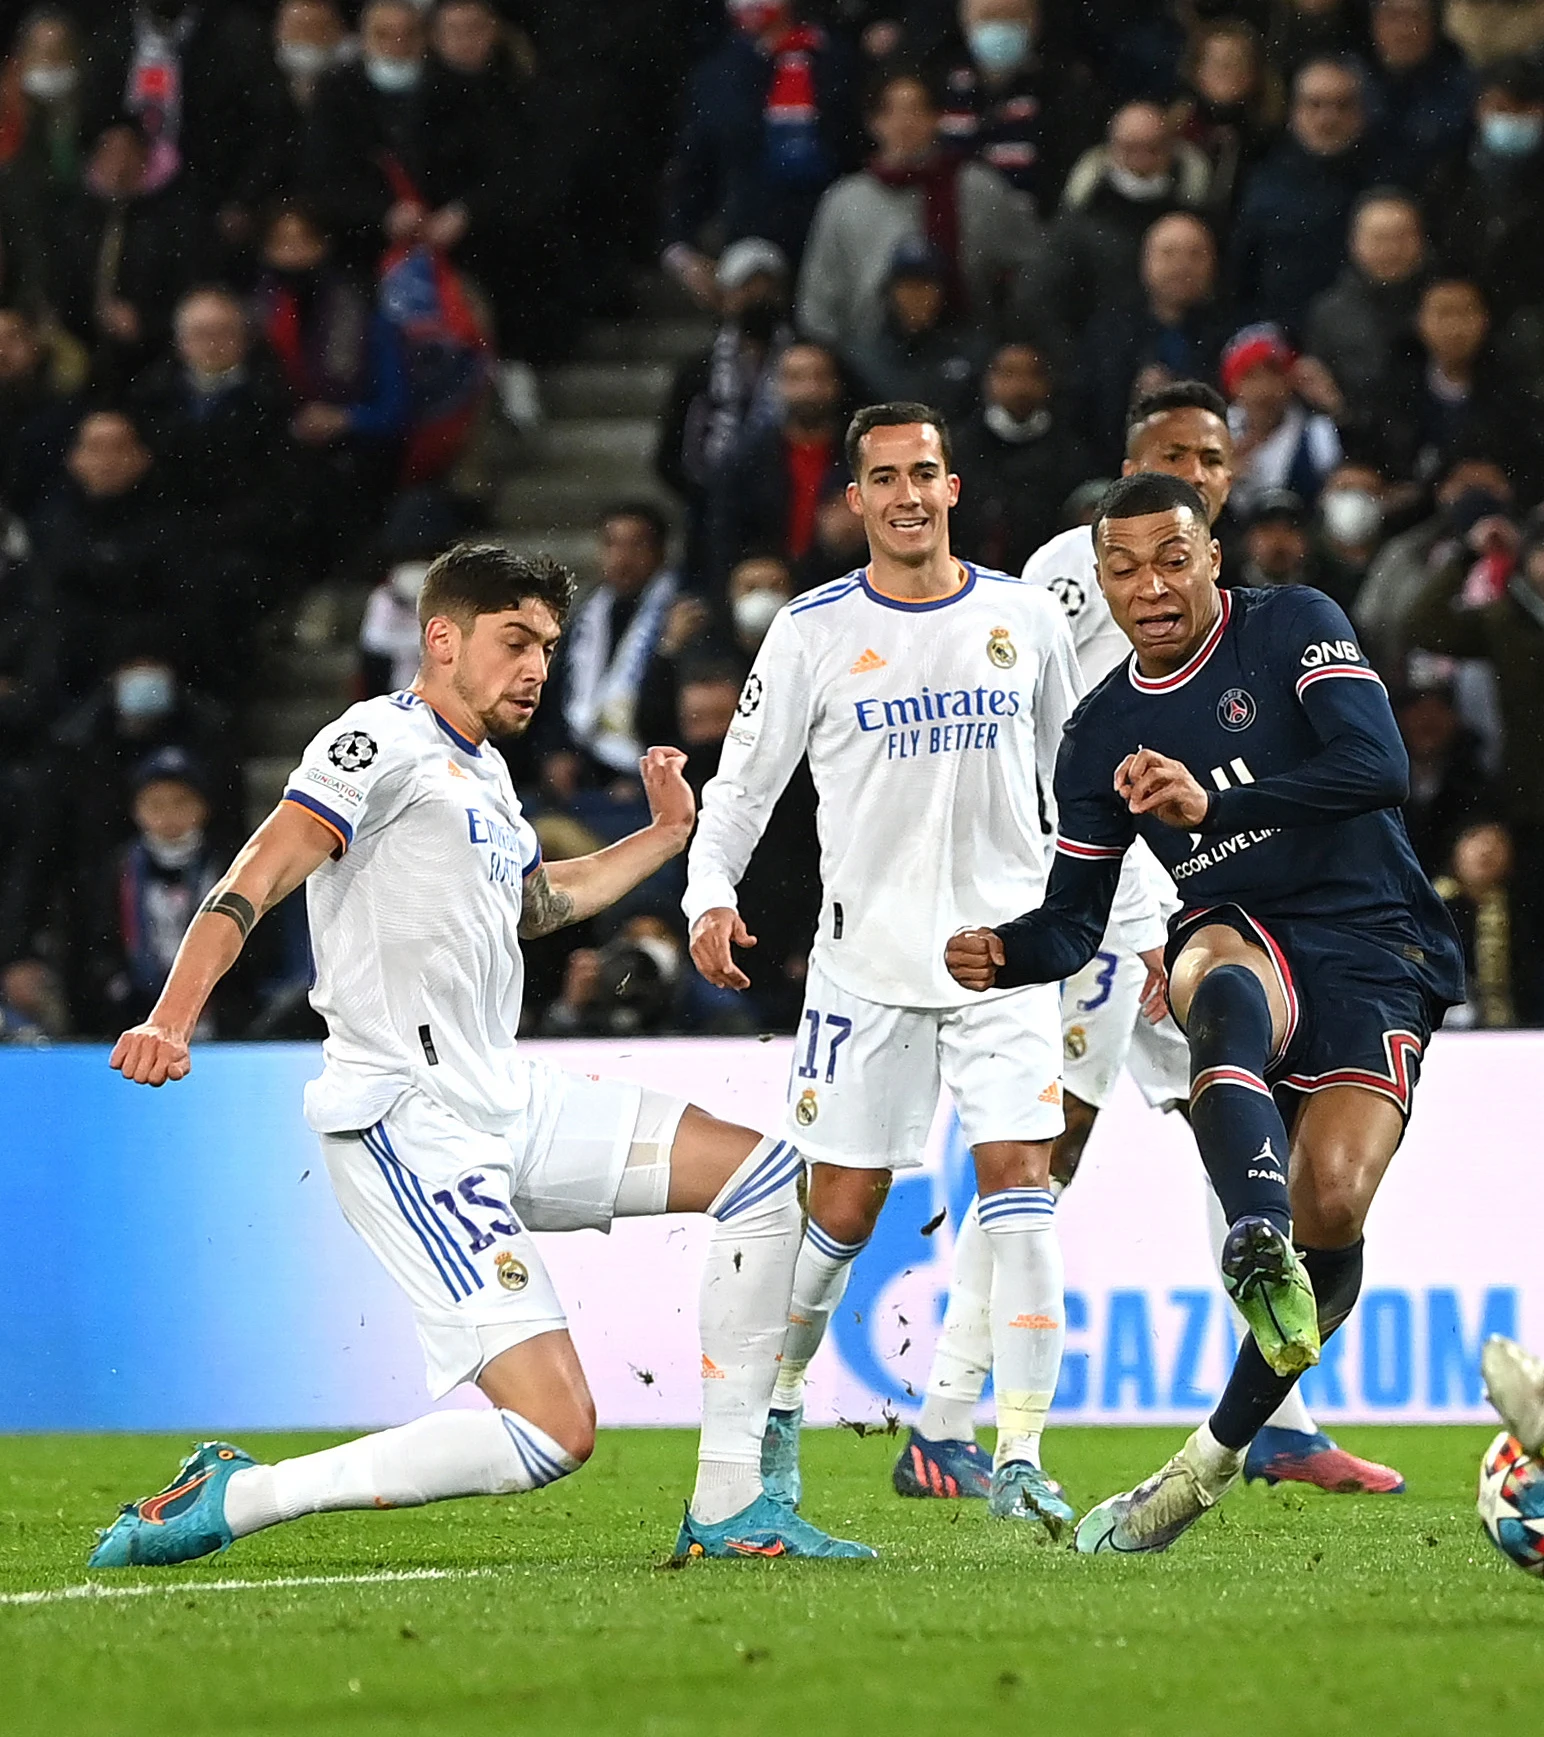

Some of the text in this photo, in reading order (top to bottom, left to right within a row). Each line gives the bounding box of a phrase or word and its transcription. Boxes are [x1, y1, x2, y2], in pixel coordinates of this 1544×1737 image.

[1300, 640, 1360, 667] QNB
[854, 685, 1020, 732] Emirates
[887, 722, 998, 760] FLY BETTER
[306, 771, 363, 802] OUNDATION
[1211, 832, 1251, 863] LIVE
[1076, 951, 1118, 1012] 3
[798, 1009, 852, 1084] 17
[432, 1173, 522, 1255] 15
[1051, 1287, 1517, 1409] GAZOM
